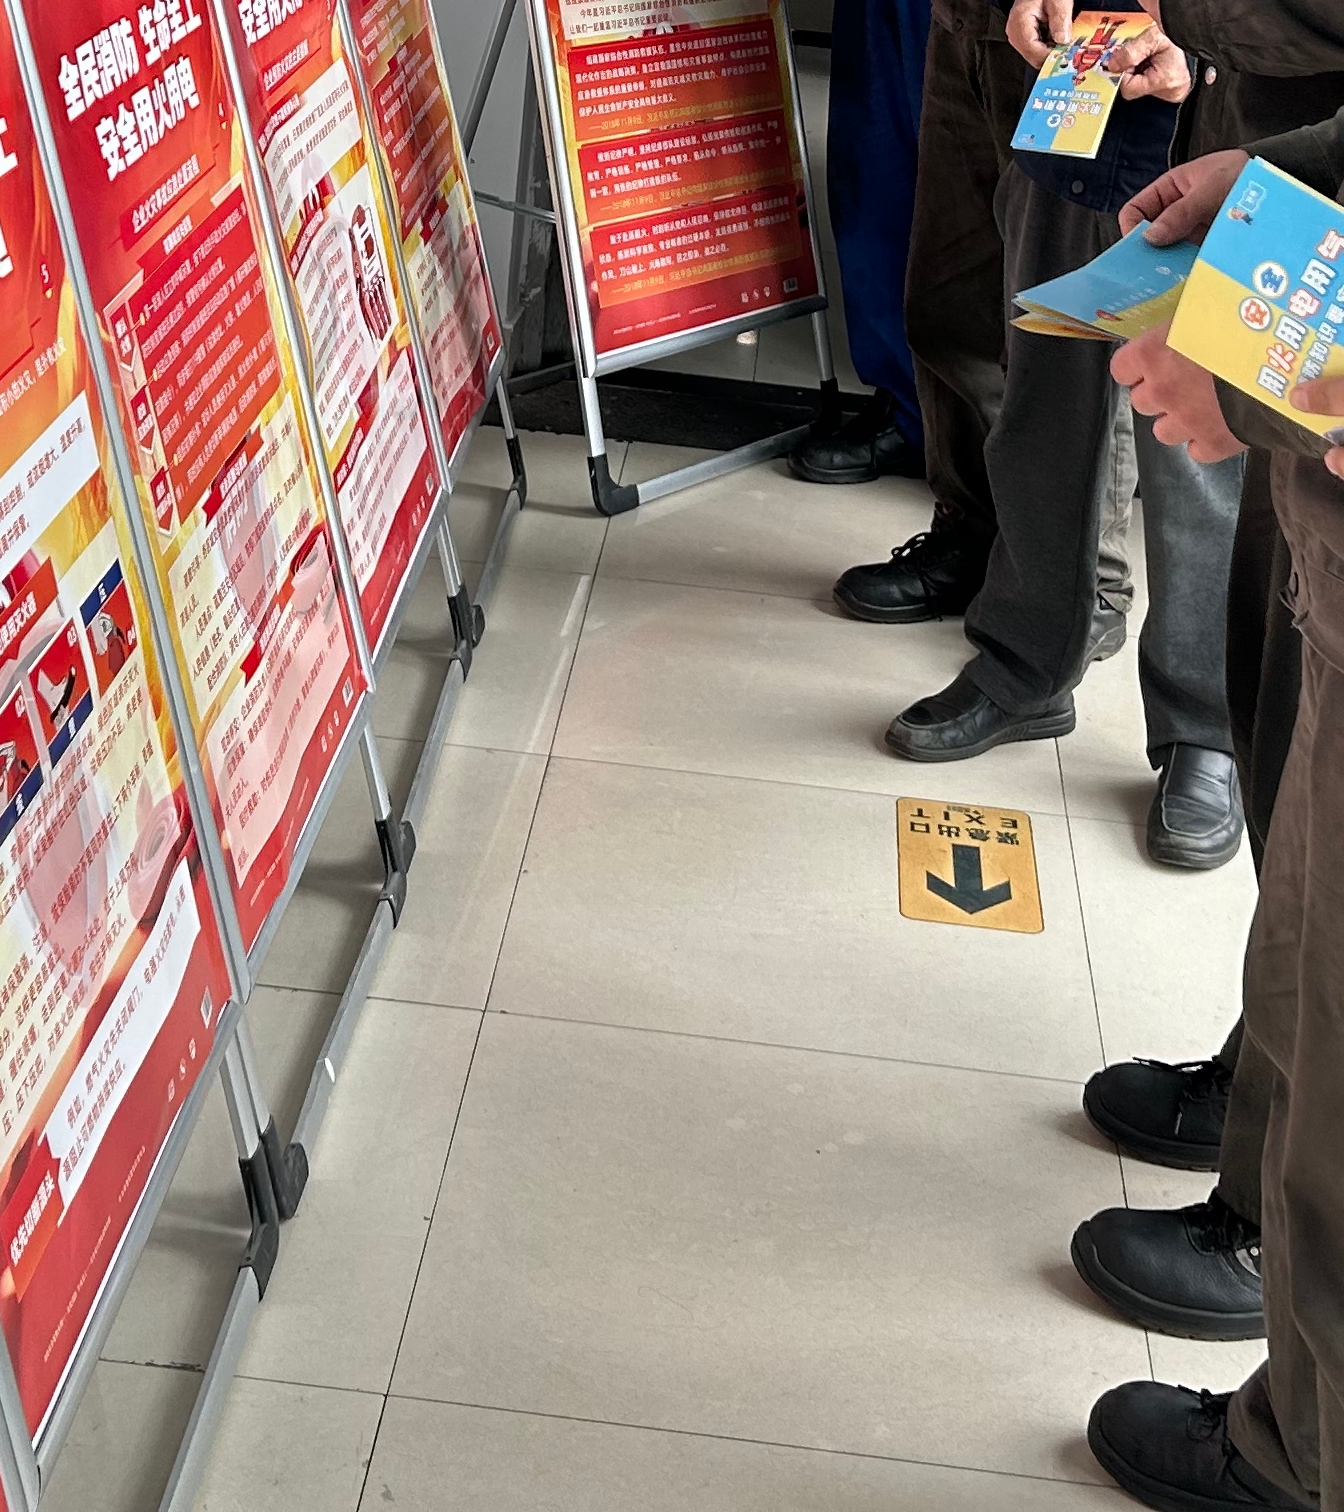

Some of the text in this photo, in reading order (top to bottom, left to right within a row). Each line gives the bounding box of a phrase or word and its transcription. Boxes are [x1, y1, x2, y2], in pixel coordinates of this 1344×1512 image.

[54, 12, 140, 126] 全民消防
[94, 51, 200, 187] 安全用火用电
[39, 261, 50, 285] 5
[65, 622, 78, 650] 03
[125, 623, 136, 647] 04
[12, 691, 26, 720] 02
[909, 807, 1018, 830] EXIT
[909, 821, 1020, 846] 紧急出口
[8, 1164, 56, 1270] 优先切断源头
